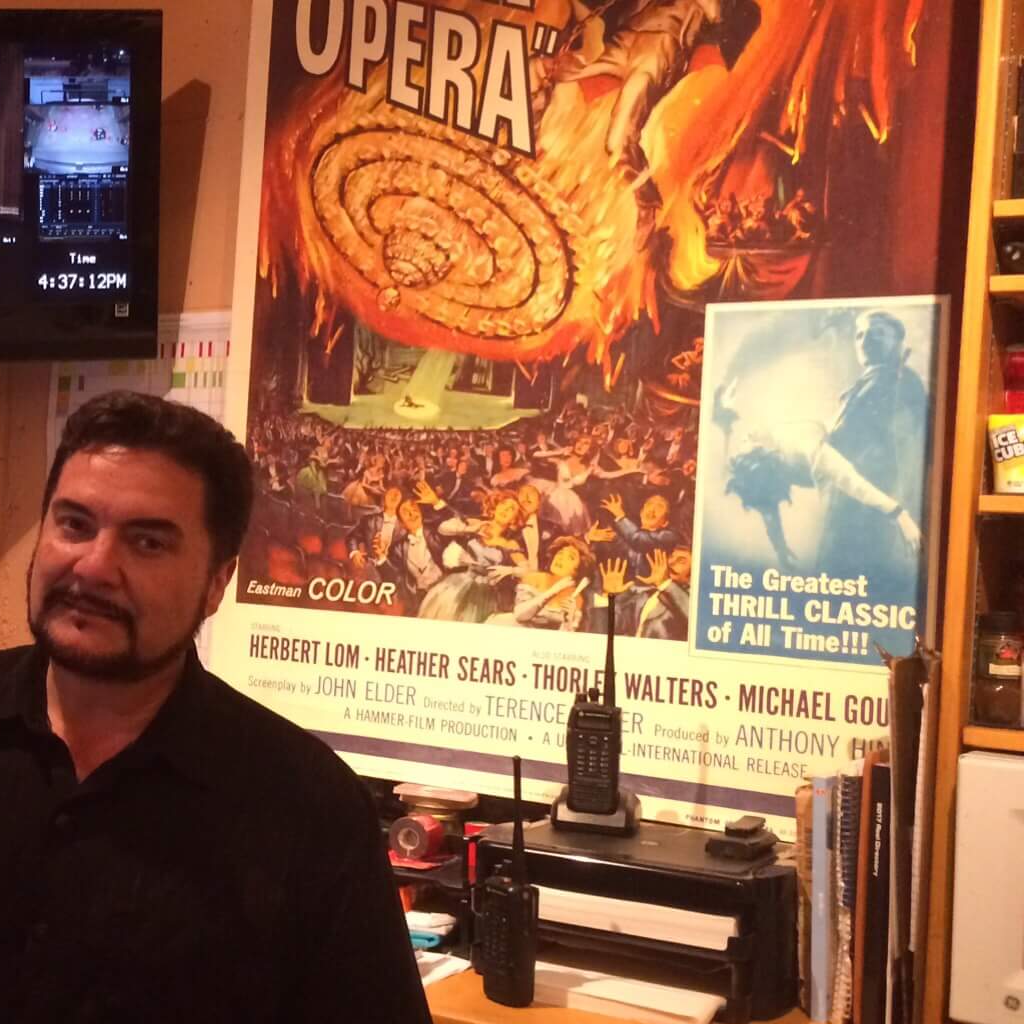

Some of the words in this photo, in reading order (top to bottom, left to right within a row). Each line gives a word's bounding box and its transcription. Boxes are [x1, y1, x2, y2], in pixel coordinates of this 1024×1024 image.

[69, 252, 97, 264] Time
[38, 273, 127, 290] 4:37:12PM
[992, 430, 1019, 449] ICE
[247, 580, 302, 598] Eastman
[308, 577, 396, 605] COLOR
[710, 565, 753, 589] The
[762, 568, 868, 597] Greatest
[709, 593, 796, 620] THRILL
[804, 600, 917, 630] CLASSIC
[707, 621, 732, 643] of
[740, 623, 771, 647] All
[780, 626, 869, 655] Time!!!
[249, 634, 321, 664] HERBERT
[324, 642, 360, 669] LOM
[375, 647, 450, 679] HEATHER
[457, 656, 517, 686] SEARS
[532, 663, 617, 697] THORLE
[624, 672, 718, 709] WALTERS
[738, 683, 836, 722] MICHAEL
[844, 694, 889, 727] GOU
[247, 675, 297, 693] Screenplay
[300, 678, 312, 695] by
[314, 676, 357, 699] JOHN
[365, 681, 416, 706] ELDER
[423, 696, 465, 713] Directed
[469, 700, 482, 716] by
[485, 695, 568, 724] TERENCE
[343, 707, 352, 719] A
[356, 709, 436, 731] HAMMER-FILM
[441, 720, 517, 742] PRODUCTION
[542, 735, 552, 745] A
[746, 757, 808, 779] RELEASE
[654, 723, 710, 743] Produced
[715, 731, 730, 747] by
[735, 724, 840, 759] ANTHONY
